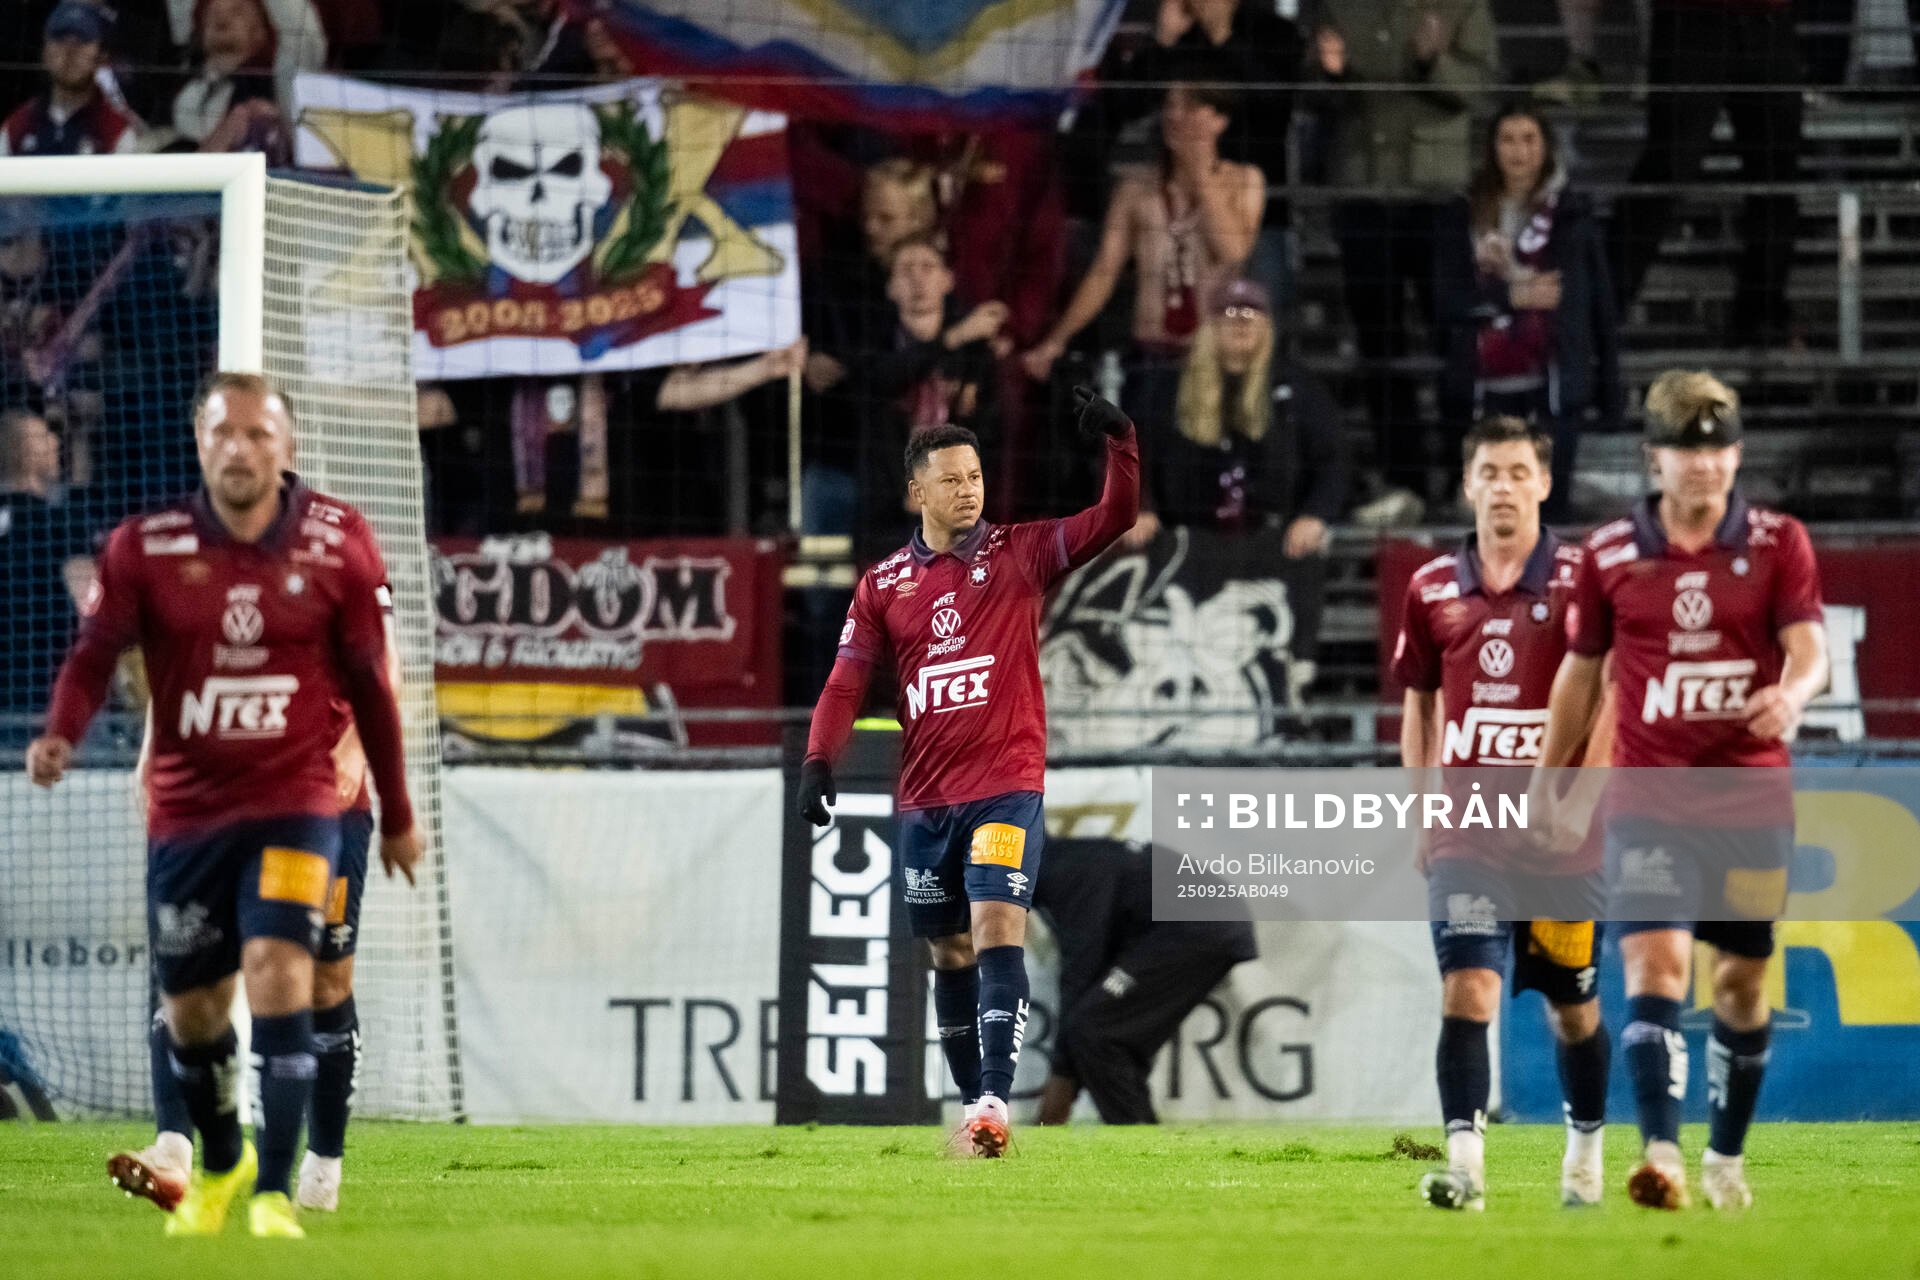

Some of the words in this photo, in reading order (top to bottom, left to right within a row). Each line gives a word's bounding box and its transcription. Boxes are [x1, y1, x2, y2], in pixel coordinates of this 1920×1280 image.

[932, 591, 957, 609] NTEX
[932, 608, 961, 638] VW
[928, 636, 966, 652] facoring
[179, 674, 299, 740] NTEX
[906, 654, 995, 719] NTEX
[1642, 659, 1757, 724] NTEX
[1442, 707, 1551, 766] NTEX
[906, 890, 945, 898] STIFTELSEN
[806, 792, 893, 1096] SELECT
